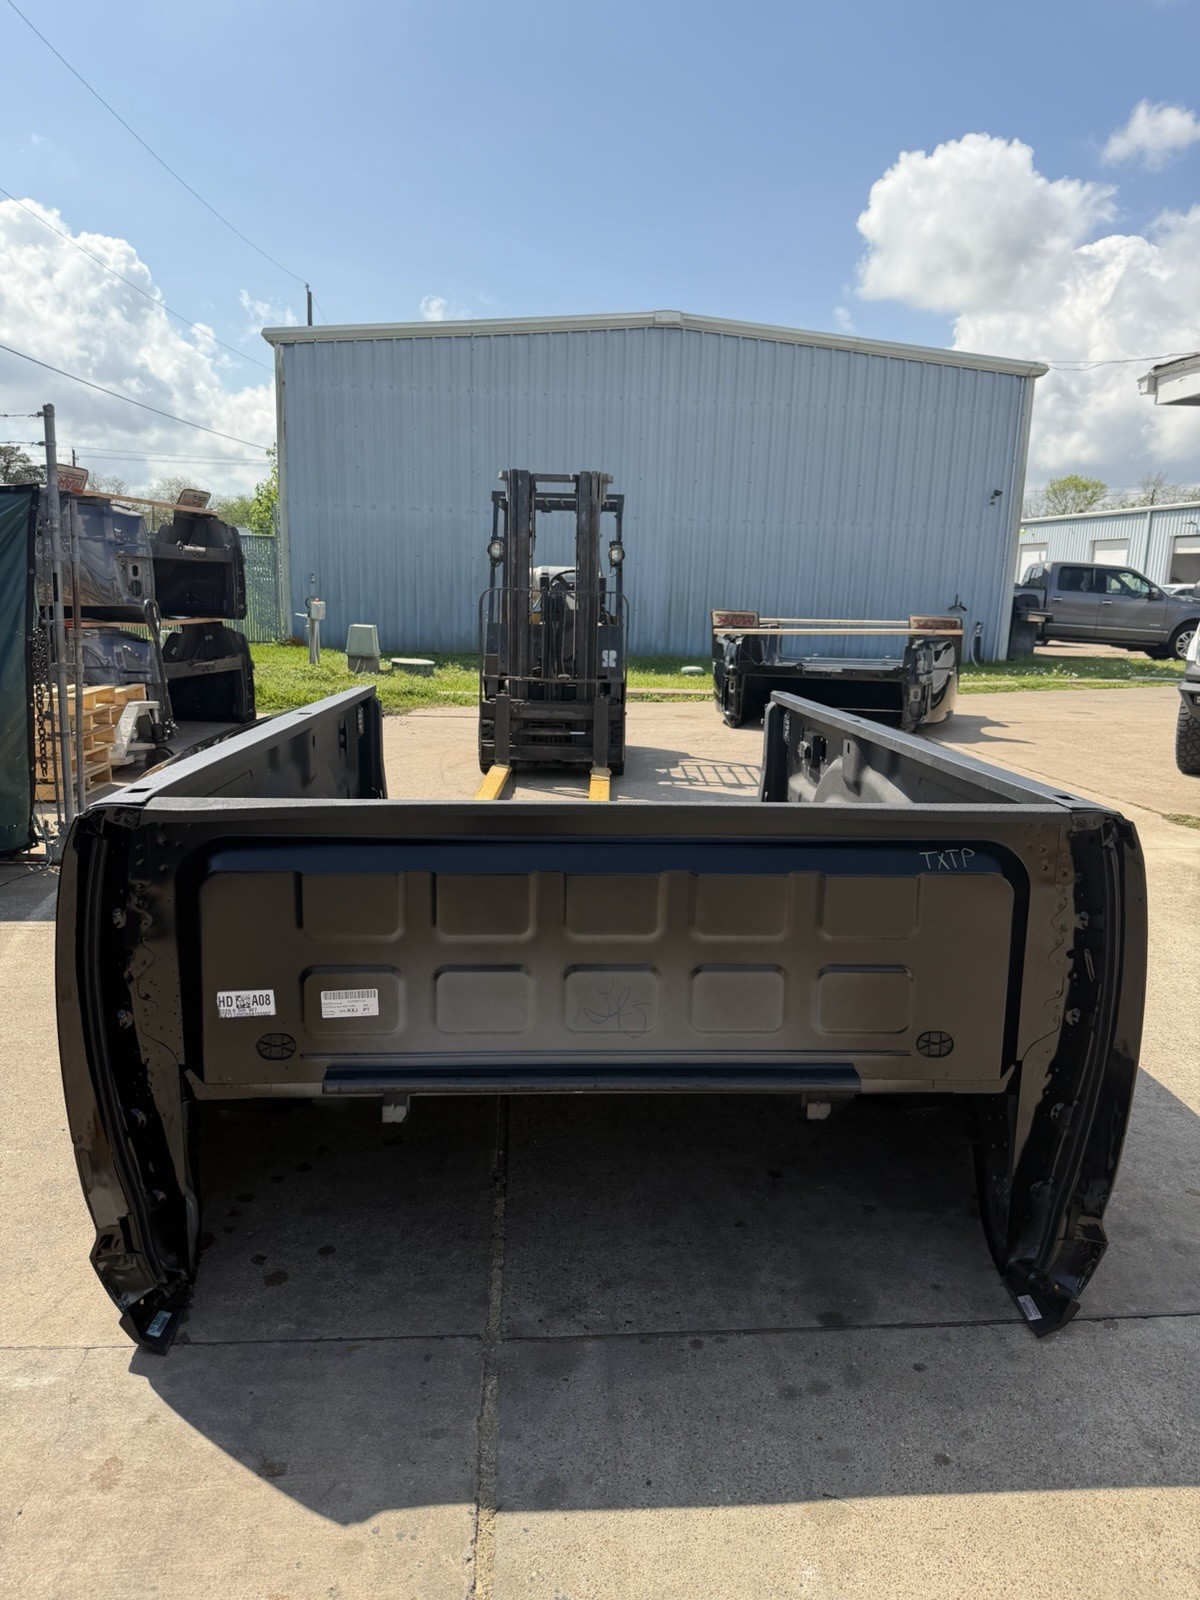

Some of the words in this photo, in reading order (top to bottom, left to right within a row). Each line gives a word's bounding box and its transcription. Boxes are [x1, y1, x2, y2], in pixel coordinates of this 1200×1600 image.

[919, 848, 976, 869] TXTP
[218, 996, 233, 1008] HD
[252, 994, 271, 1006] A08
